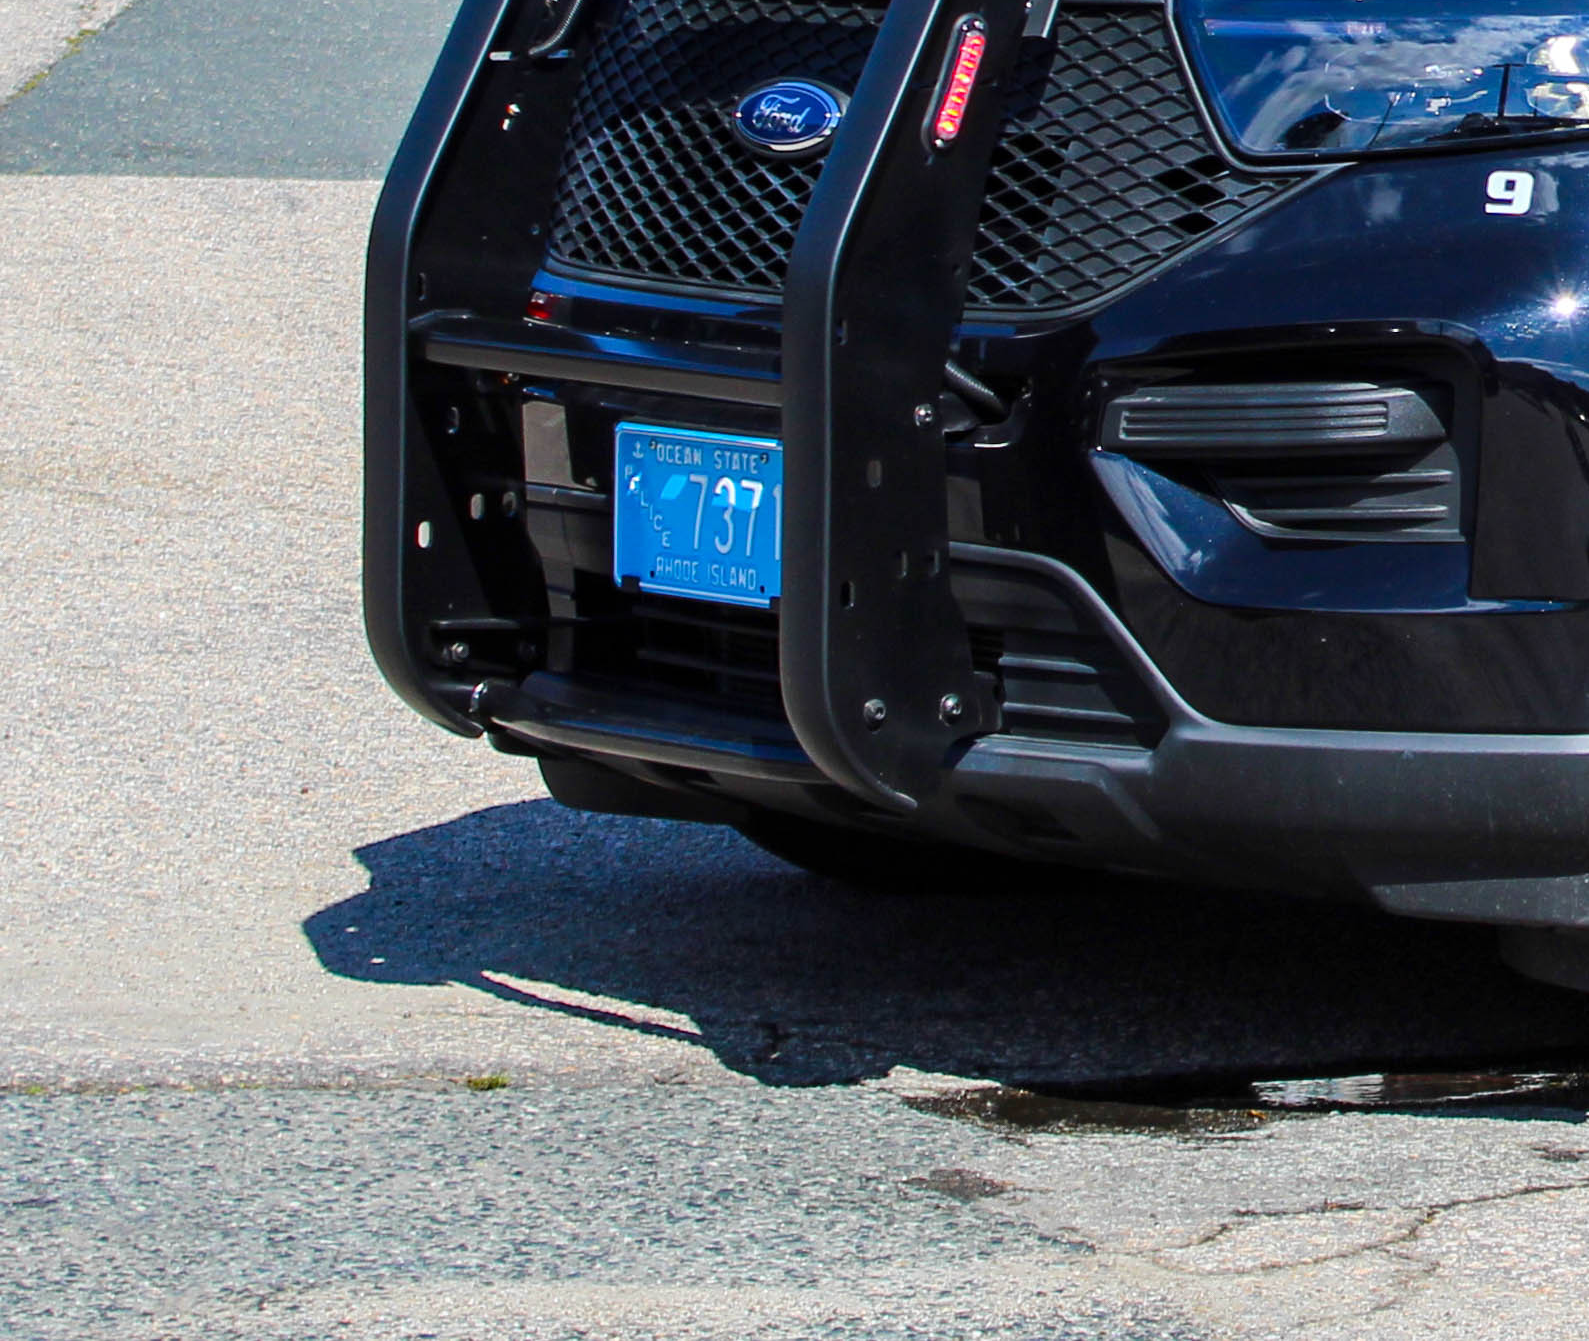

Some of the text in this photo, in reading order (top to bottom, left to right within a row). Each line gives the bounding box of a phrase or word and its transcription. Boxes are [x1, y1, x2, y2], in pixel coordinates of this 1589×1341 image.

[752, 94, 811, 133] Ford
[1485, 170, 1534, 214] 9
[656, 443, 758, 475] OCEAN STATE
[656, 556, 756, 591] RHODE ISLAND
